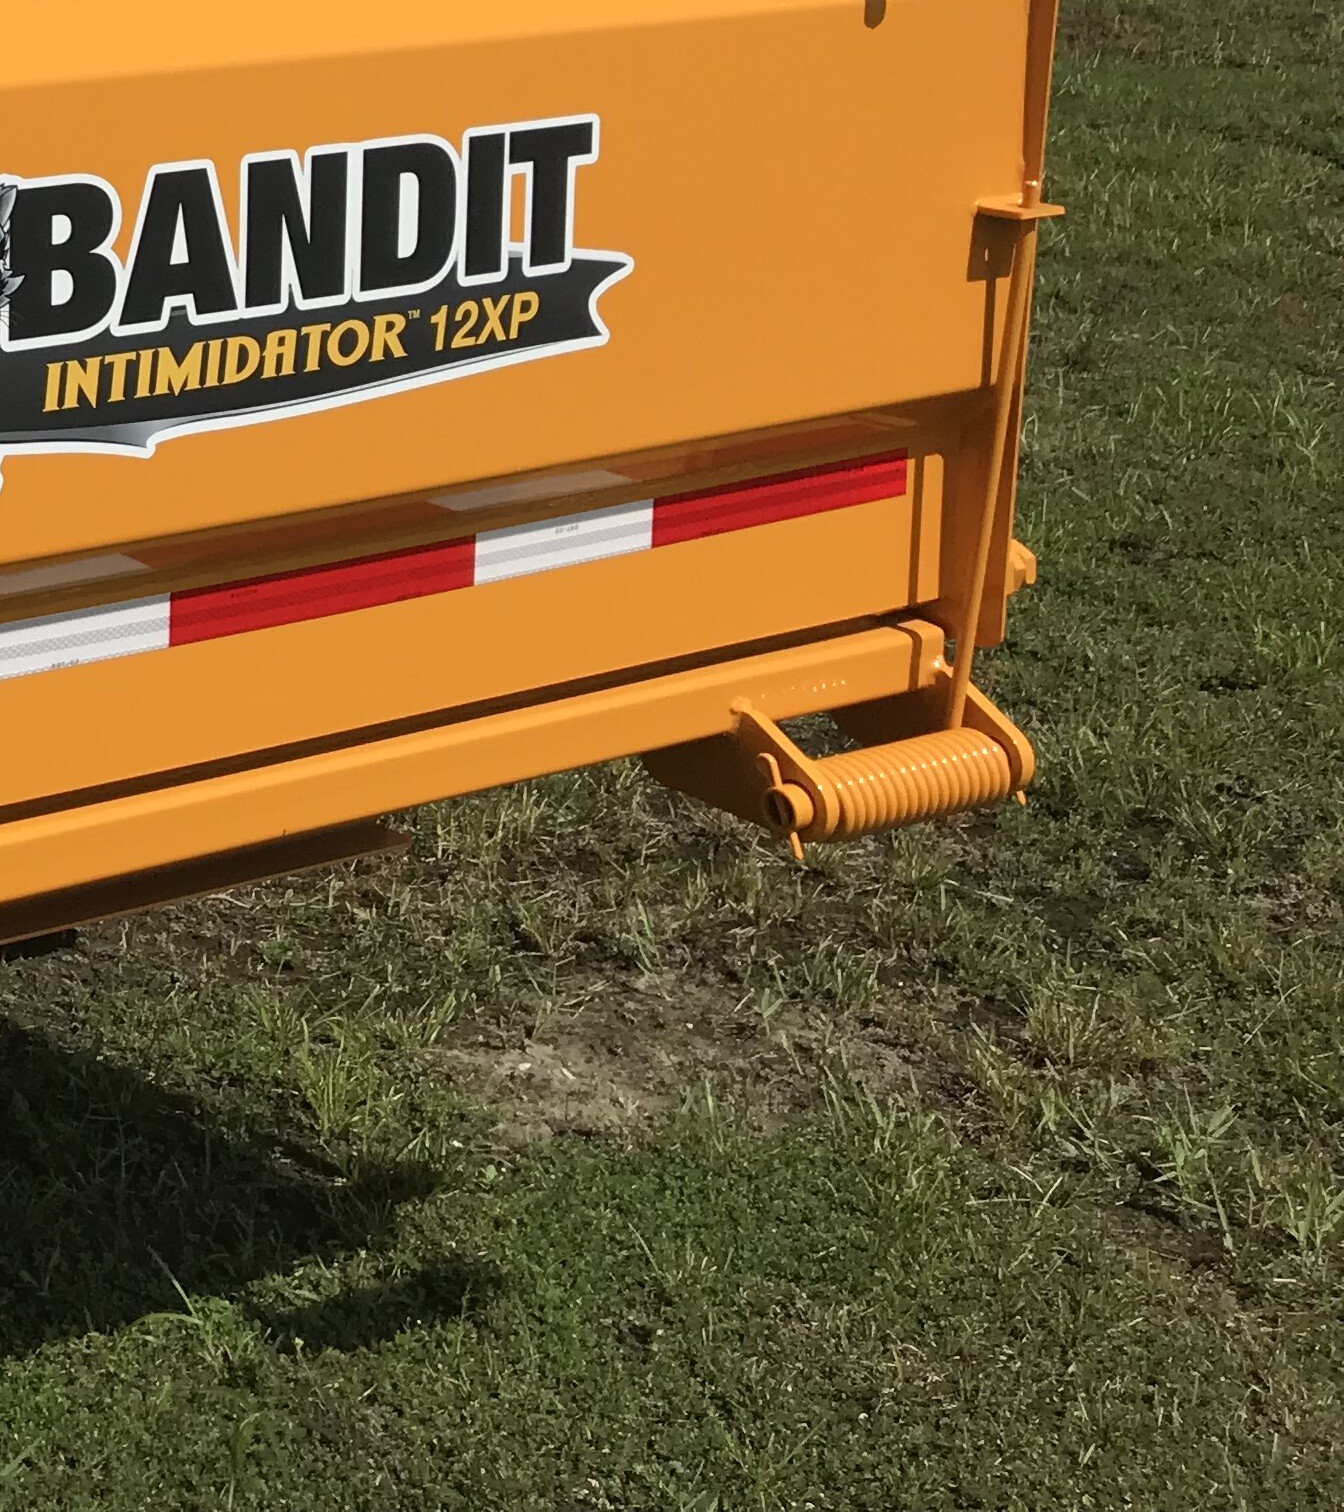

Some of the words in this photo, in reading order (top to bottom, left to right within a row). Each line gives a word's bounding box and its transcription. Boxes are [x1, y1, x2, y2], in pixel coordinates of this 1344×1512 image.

[9, 123, 594, 344] BANDIT
[41, 316, 408, 413] INTIMIDATOR
[430, 292, 540, 352] 12XP
